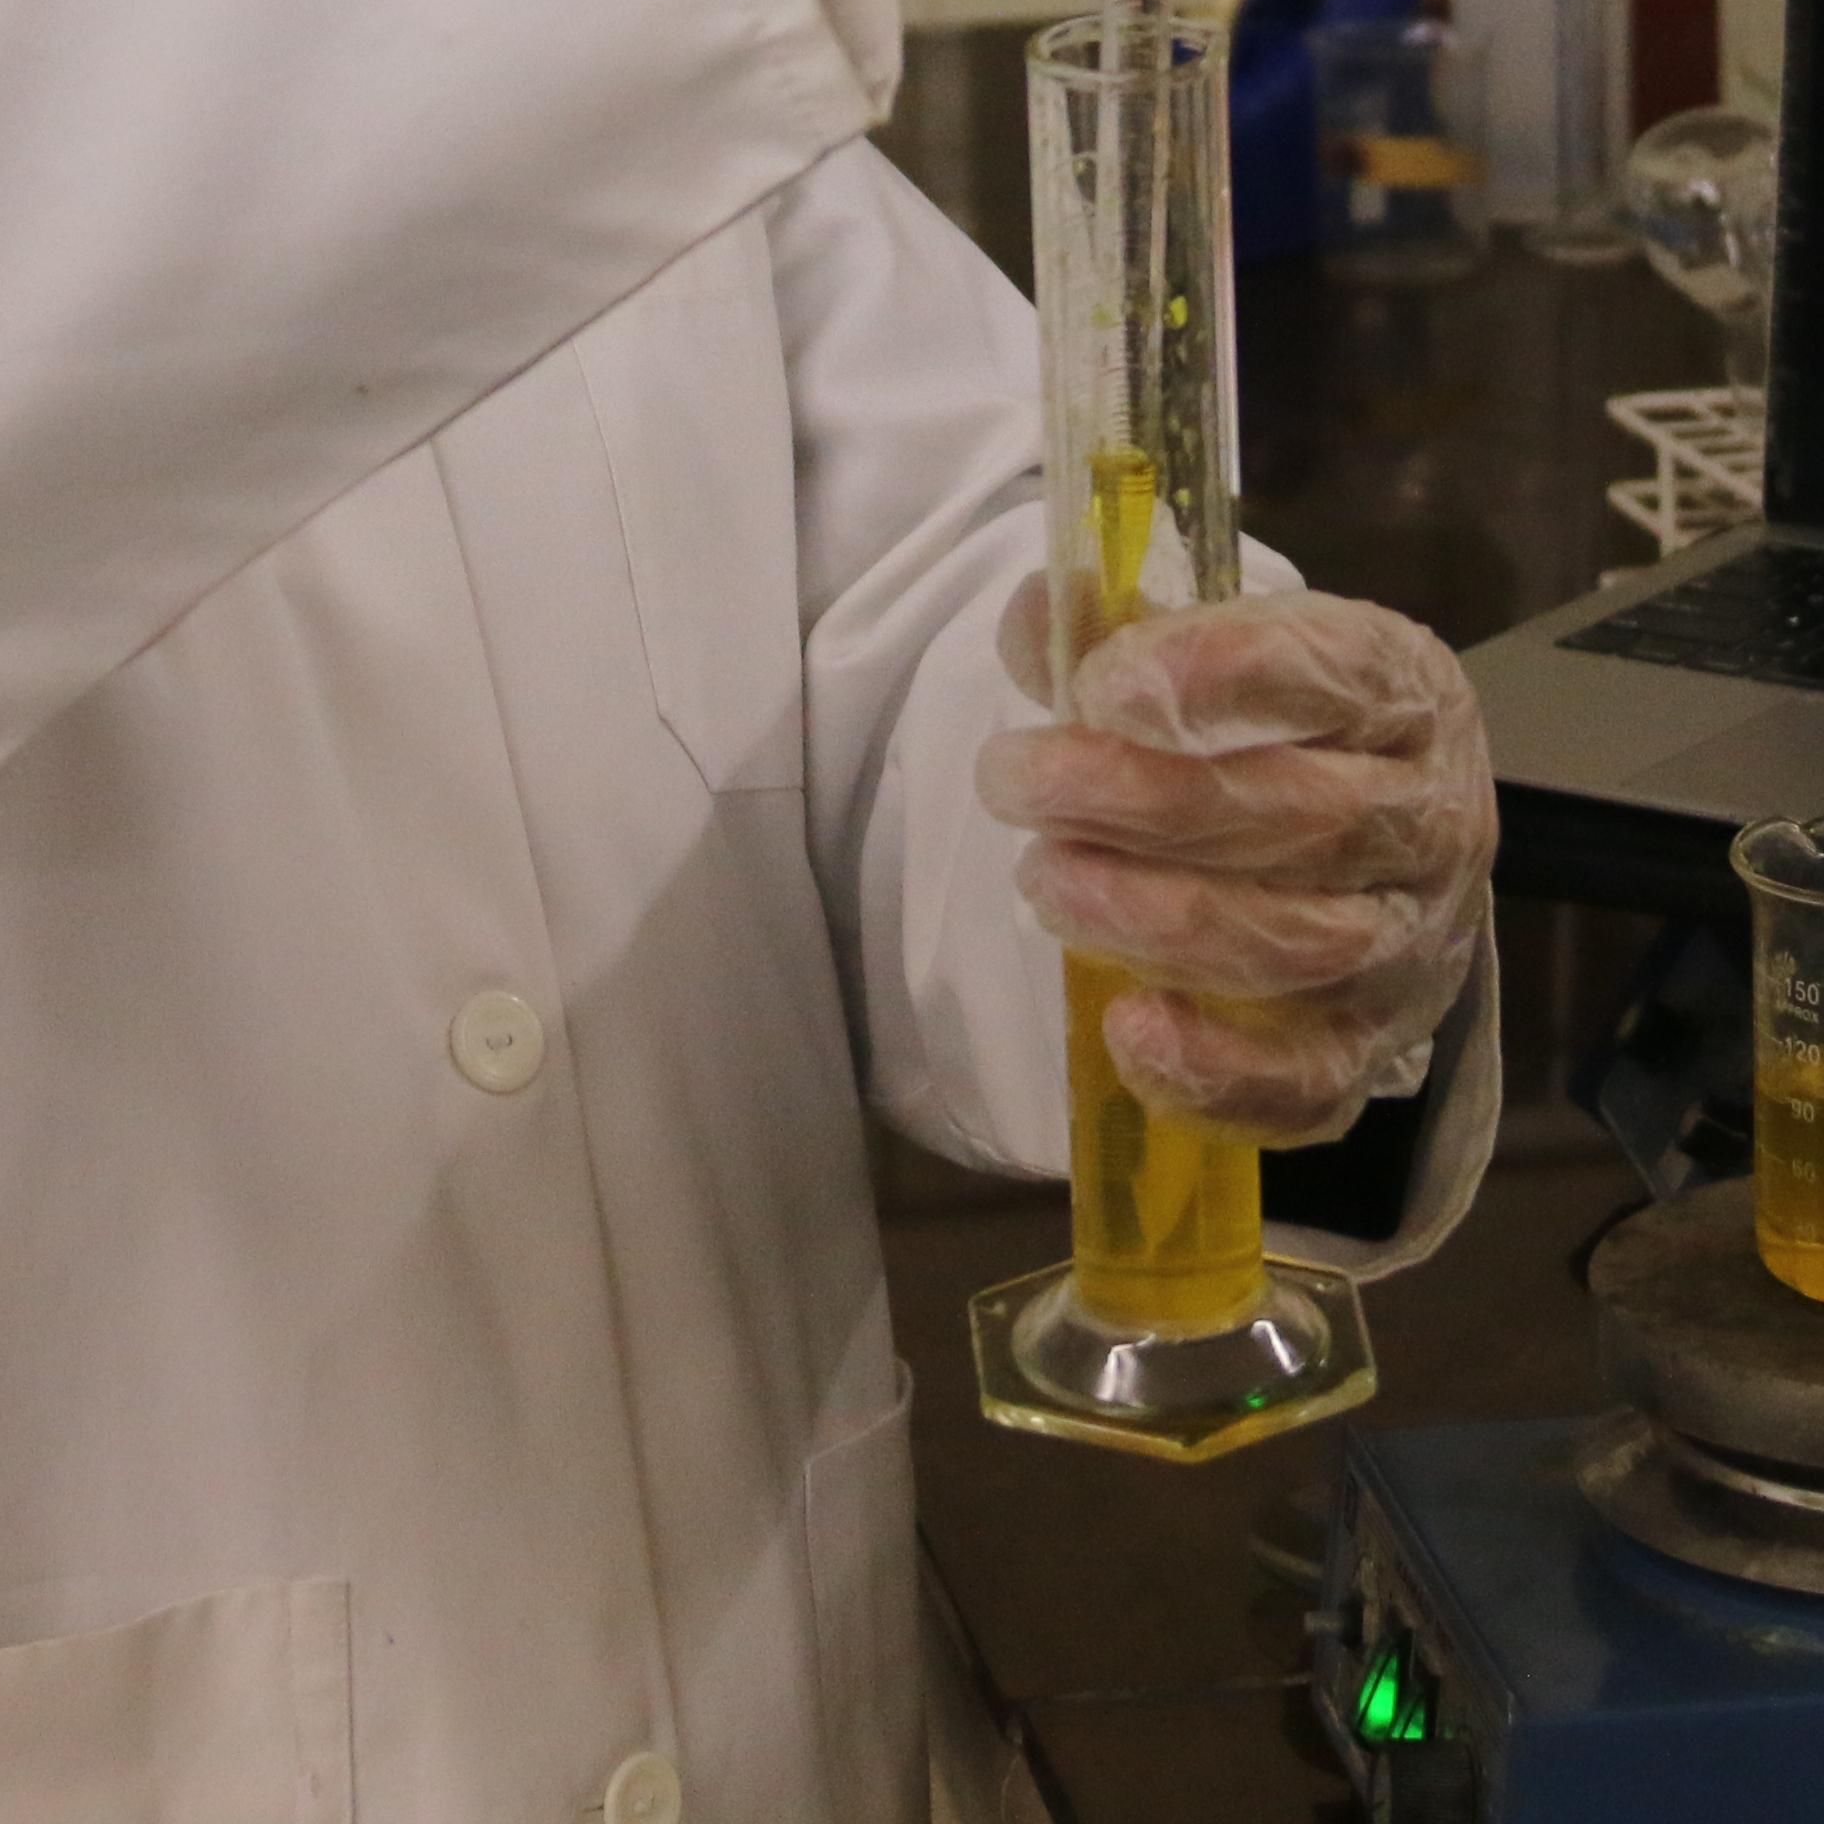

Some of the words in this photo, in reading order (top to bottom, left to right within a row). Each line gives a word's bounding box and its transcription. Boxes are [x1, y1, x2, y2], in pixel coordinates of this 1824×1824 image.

[1785, 977, 1819, 1005] 150
[1785, 1036, 1821, 1066] 120
[1791, 1098, 1815, 1124] 90
[1791, 1159, 1816, 1184] 60
